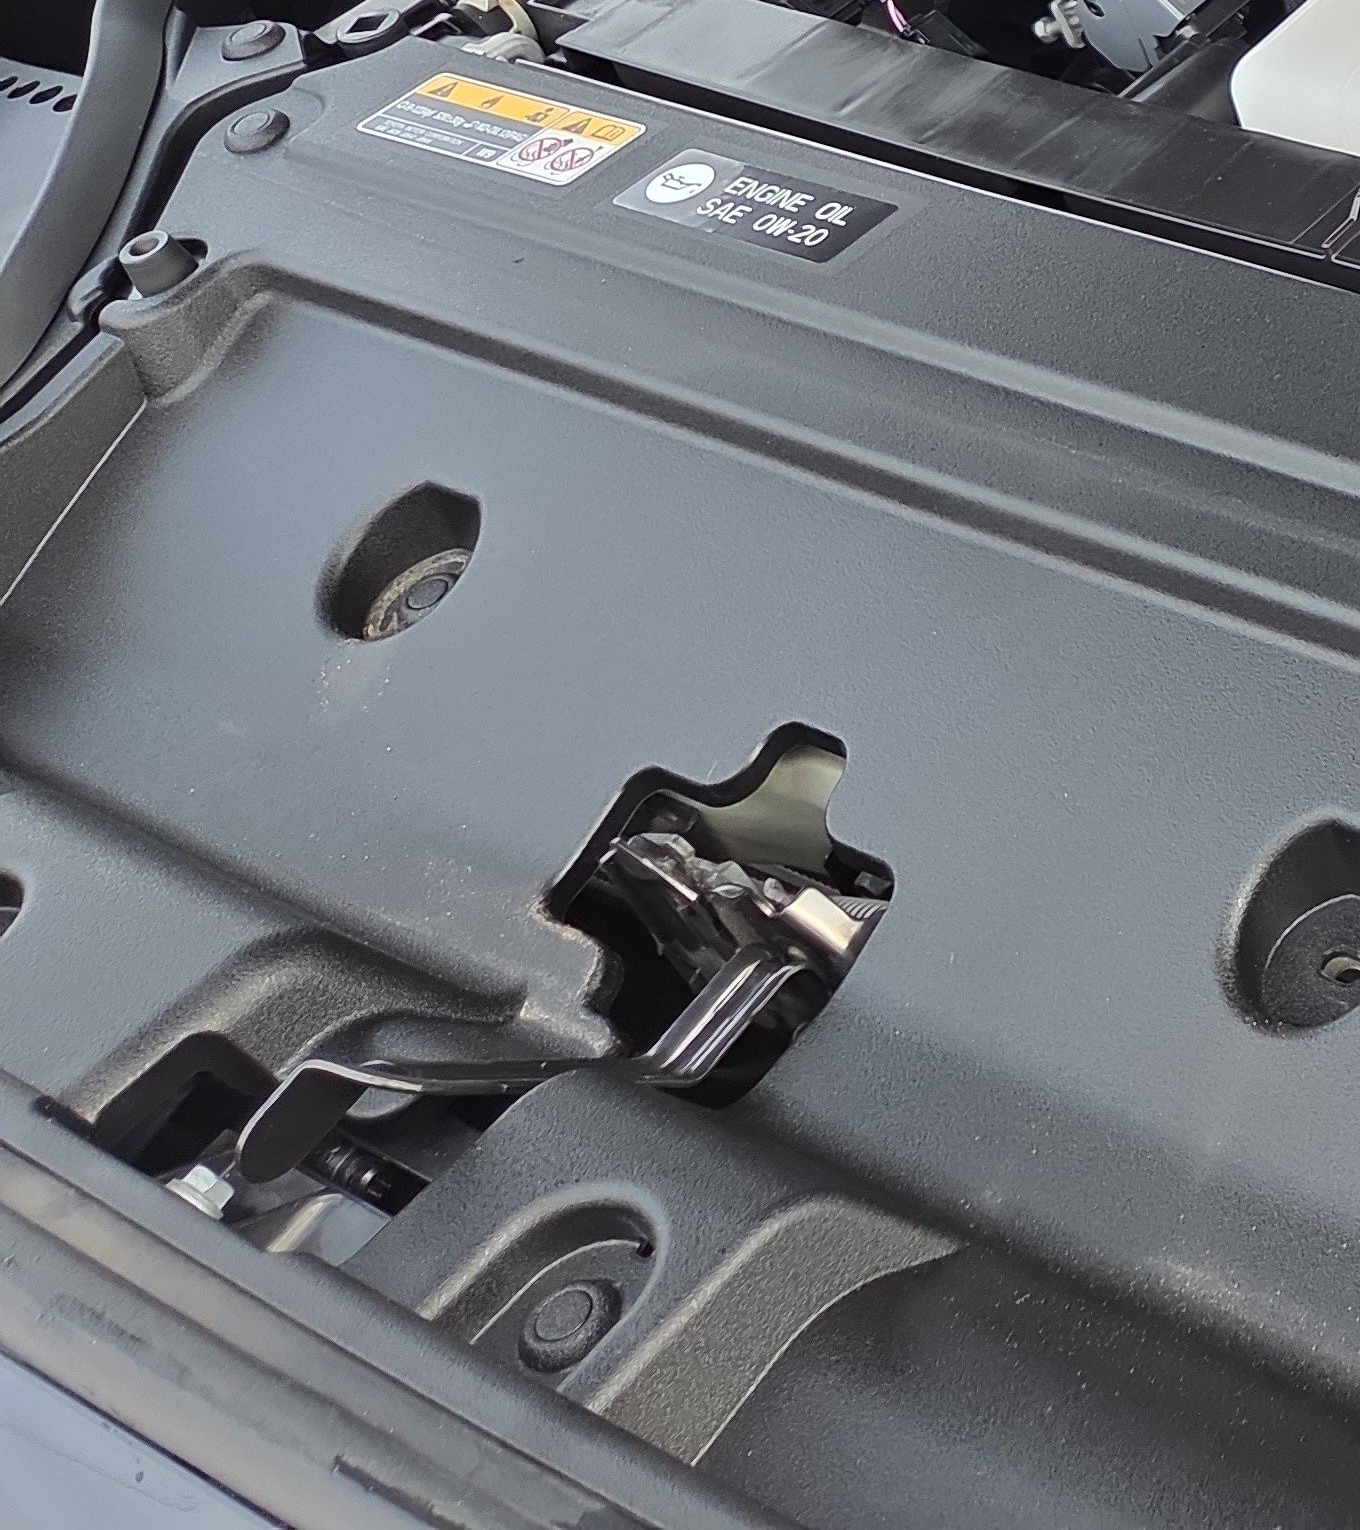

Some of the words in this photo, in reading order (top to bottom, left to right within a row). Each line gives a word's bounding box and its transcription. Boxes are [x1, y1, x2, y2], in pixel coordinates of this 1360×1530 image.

[696, 197, 753, 226] SAE
[751, 210, 831, 248] 0W-20
[722, 176, 814, 214] ENGINE
[814, 200, 856, 227] OIL
